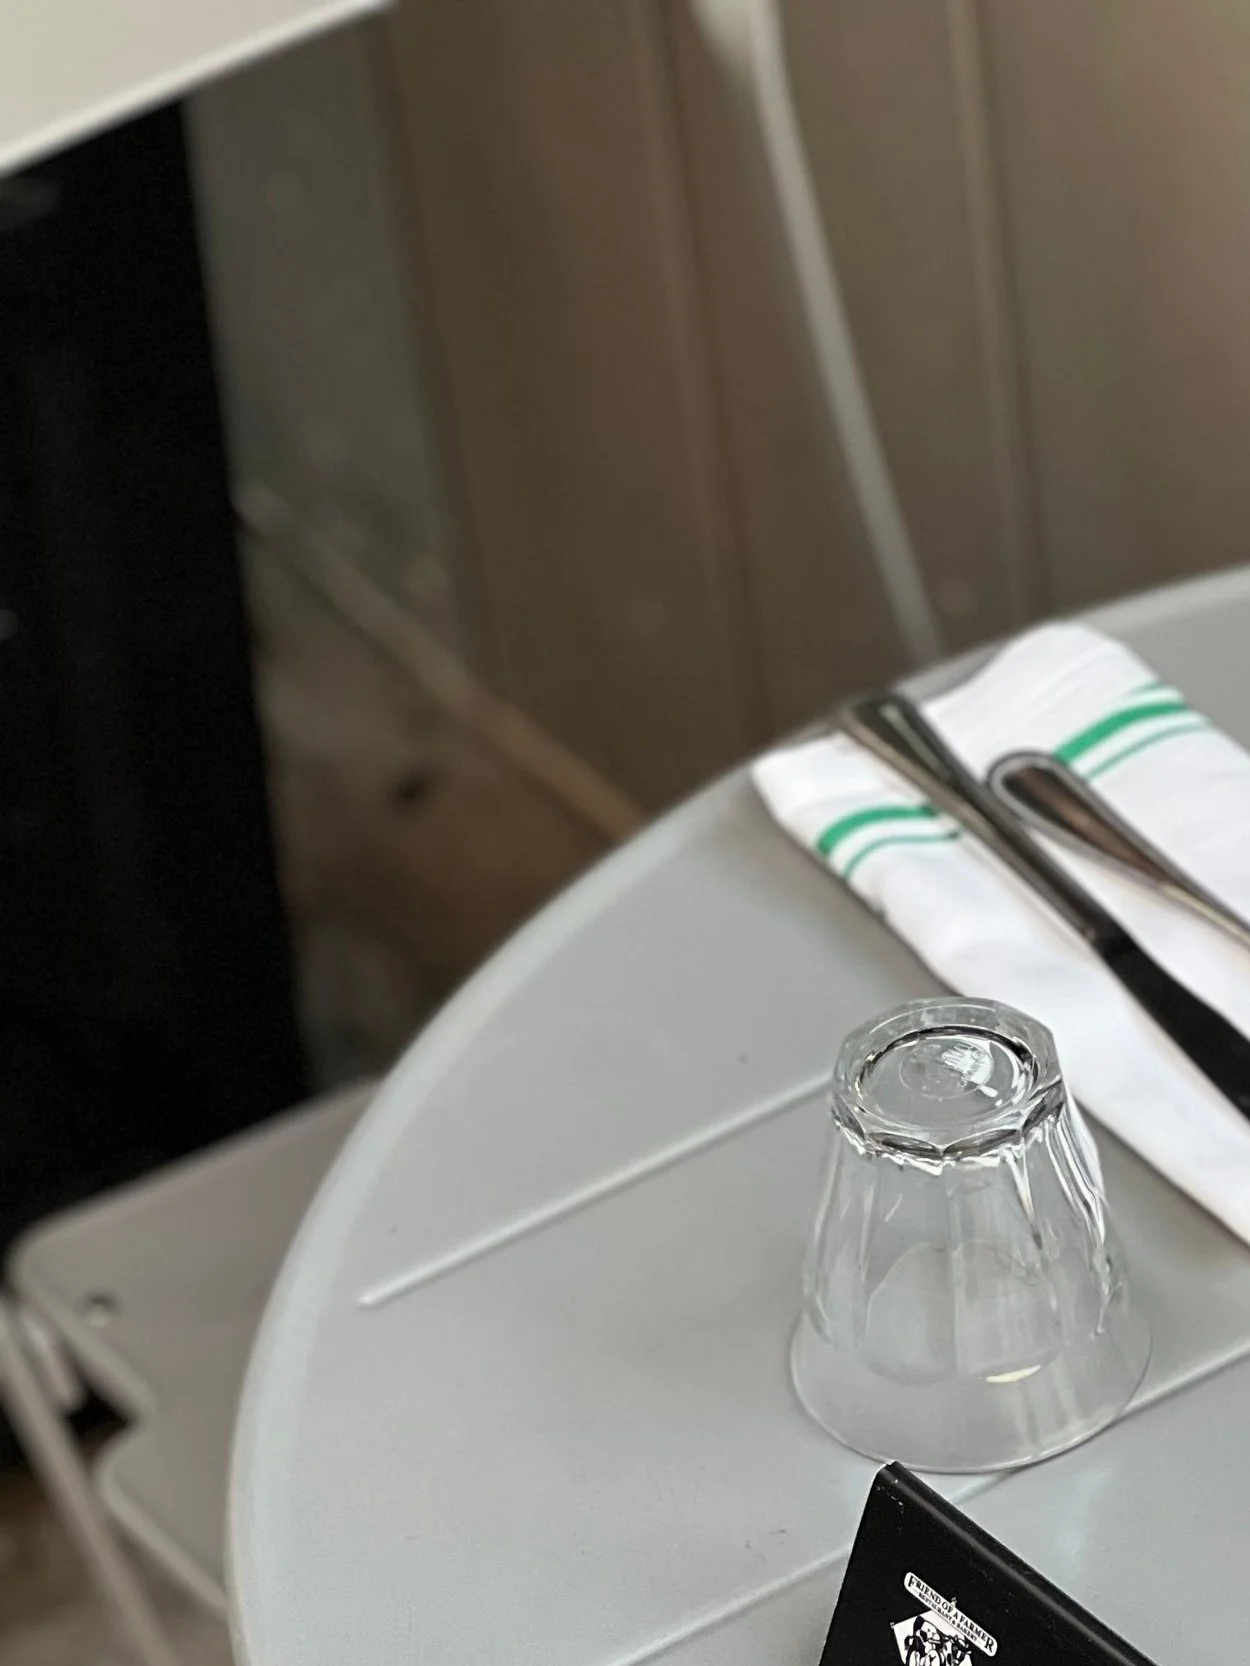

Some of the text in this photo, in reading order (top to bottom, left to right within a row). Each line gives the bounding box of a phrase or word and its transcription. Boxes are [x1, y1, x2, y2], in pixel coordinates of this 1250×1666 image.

[908, 1575, 941, 1605] FRIEND
[942, 1601, 954, 1613] OF
[960, 1616, 994, 1653] FARMER
